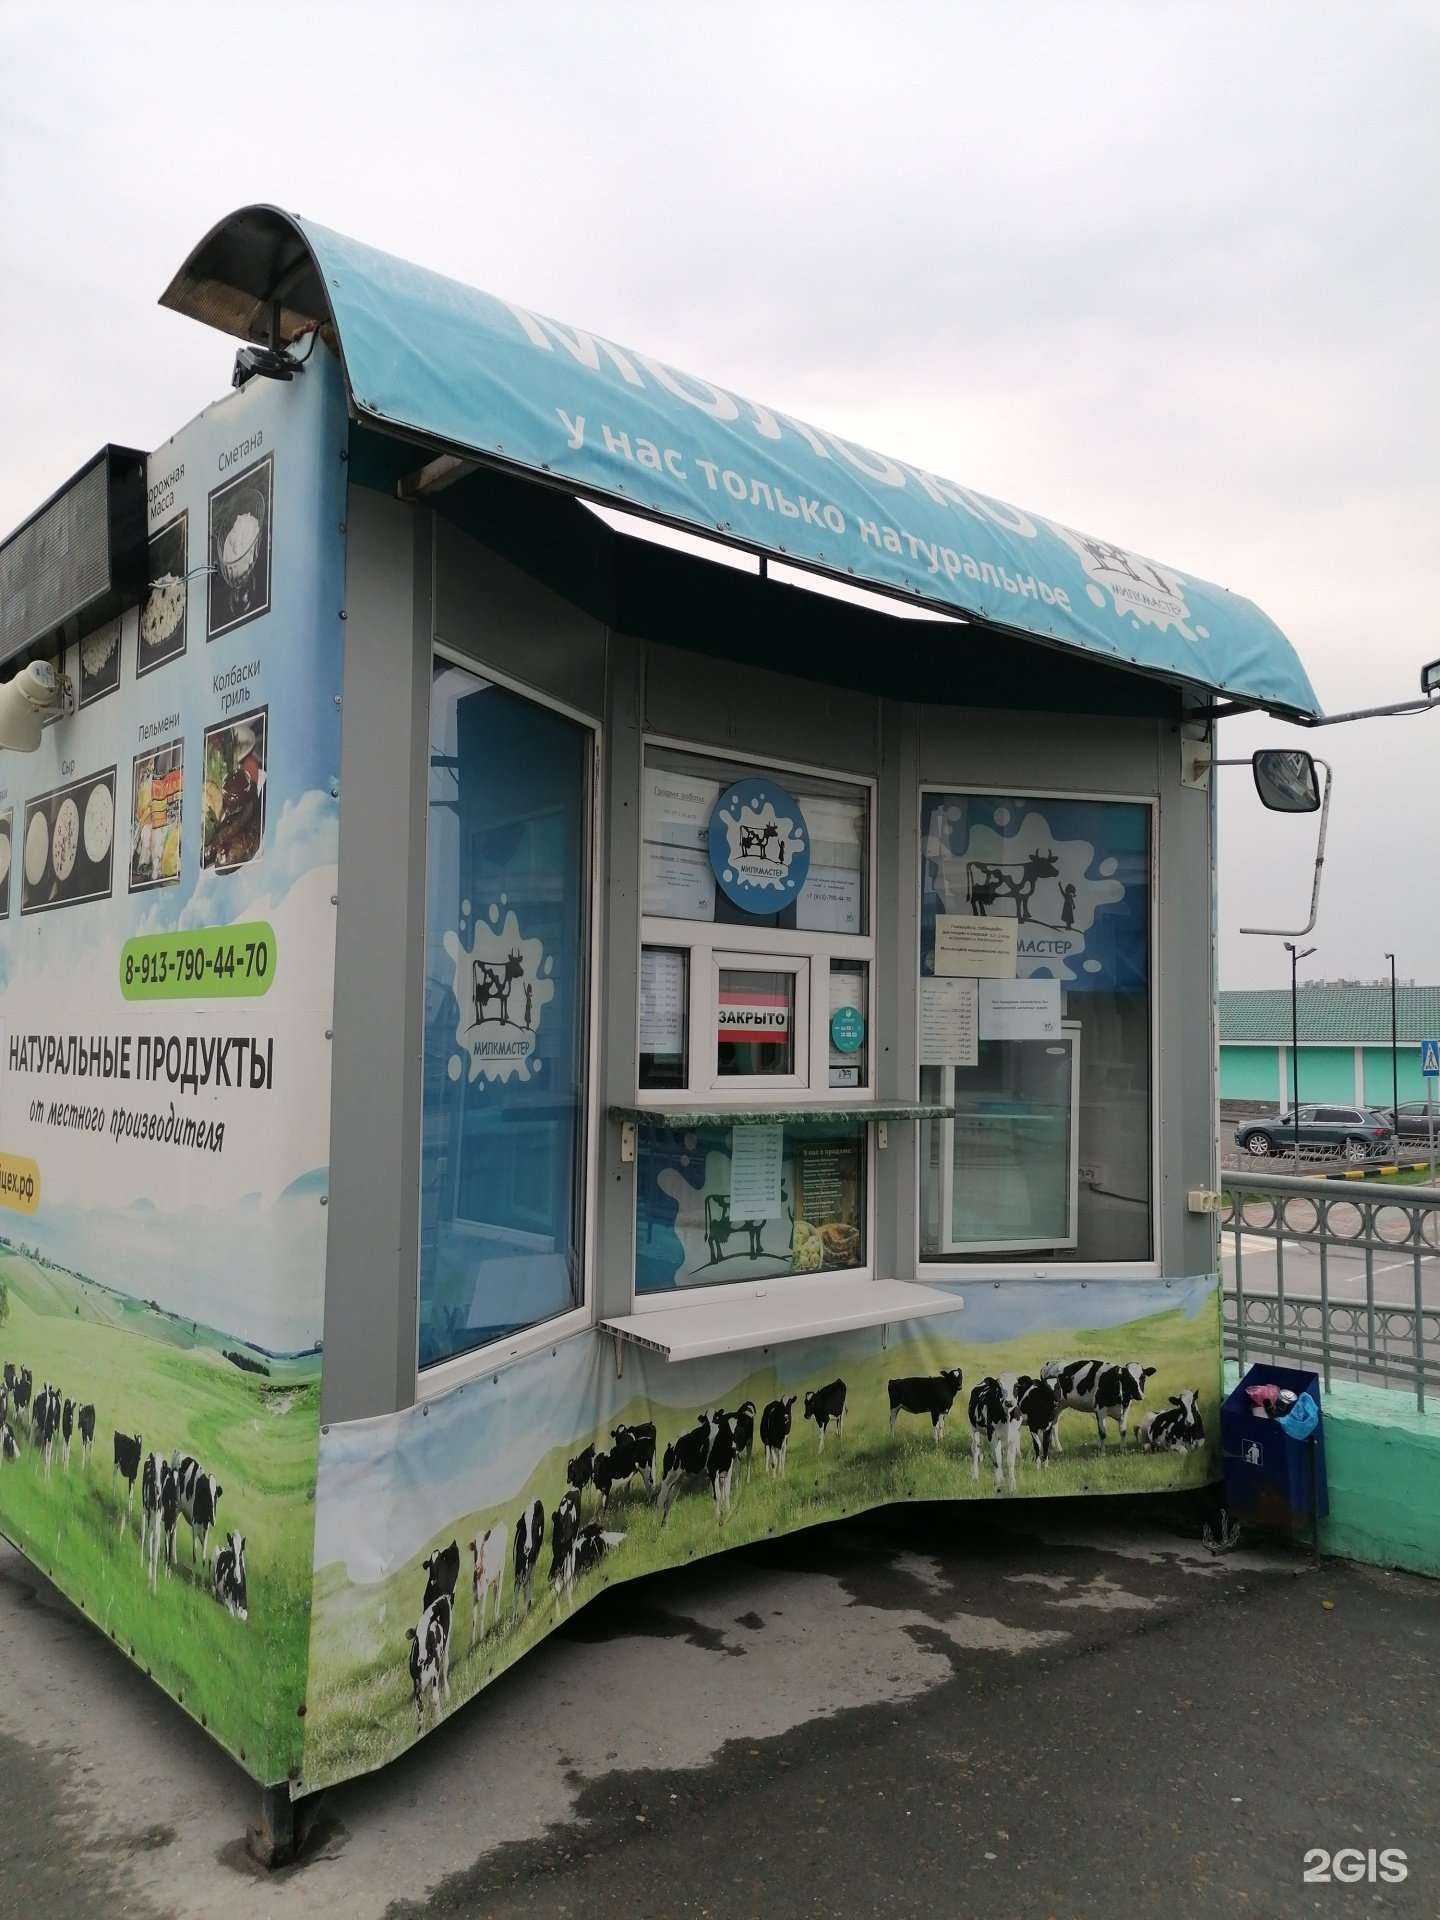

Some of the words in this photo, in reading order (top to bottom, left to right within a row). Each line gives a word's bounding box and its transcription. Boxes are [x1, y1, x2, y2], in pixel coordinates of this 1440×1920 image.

[218, 430, 263, 472] Сметана
[147, 464, 185, 504] орожная
[601, 424, 688, 480] нас
[695, 458, 846, 534] только
[858, 515, 1073, 613] натуральное
[212, 660, 261, 693] Колбаски
[220, 688, 251, 713] гриль
[138, 712, 180, 742] Пельмени
[125, 941, 268, 985] 8-913-790-44-70
[1017, 939, 1072, 955] МАСТЕР
[718, 1010, 785, 1026] ЗАКРЫТО
[9, 1034, 131, 1080] НАТУРАЛЬНЫЕ
[136, 1035, 274, 1095] ПРОДУКТЫ
[473, 1040, 530, 1056] МИЛКМАСТЕР
[29, 1099, 45, 1124] от
[47, 1100, 105, 1133] местного
[109, 1101, 225, 1152] производителя
[0, 1163, 34, 1204] цех.рф
